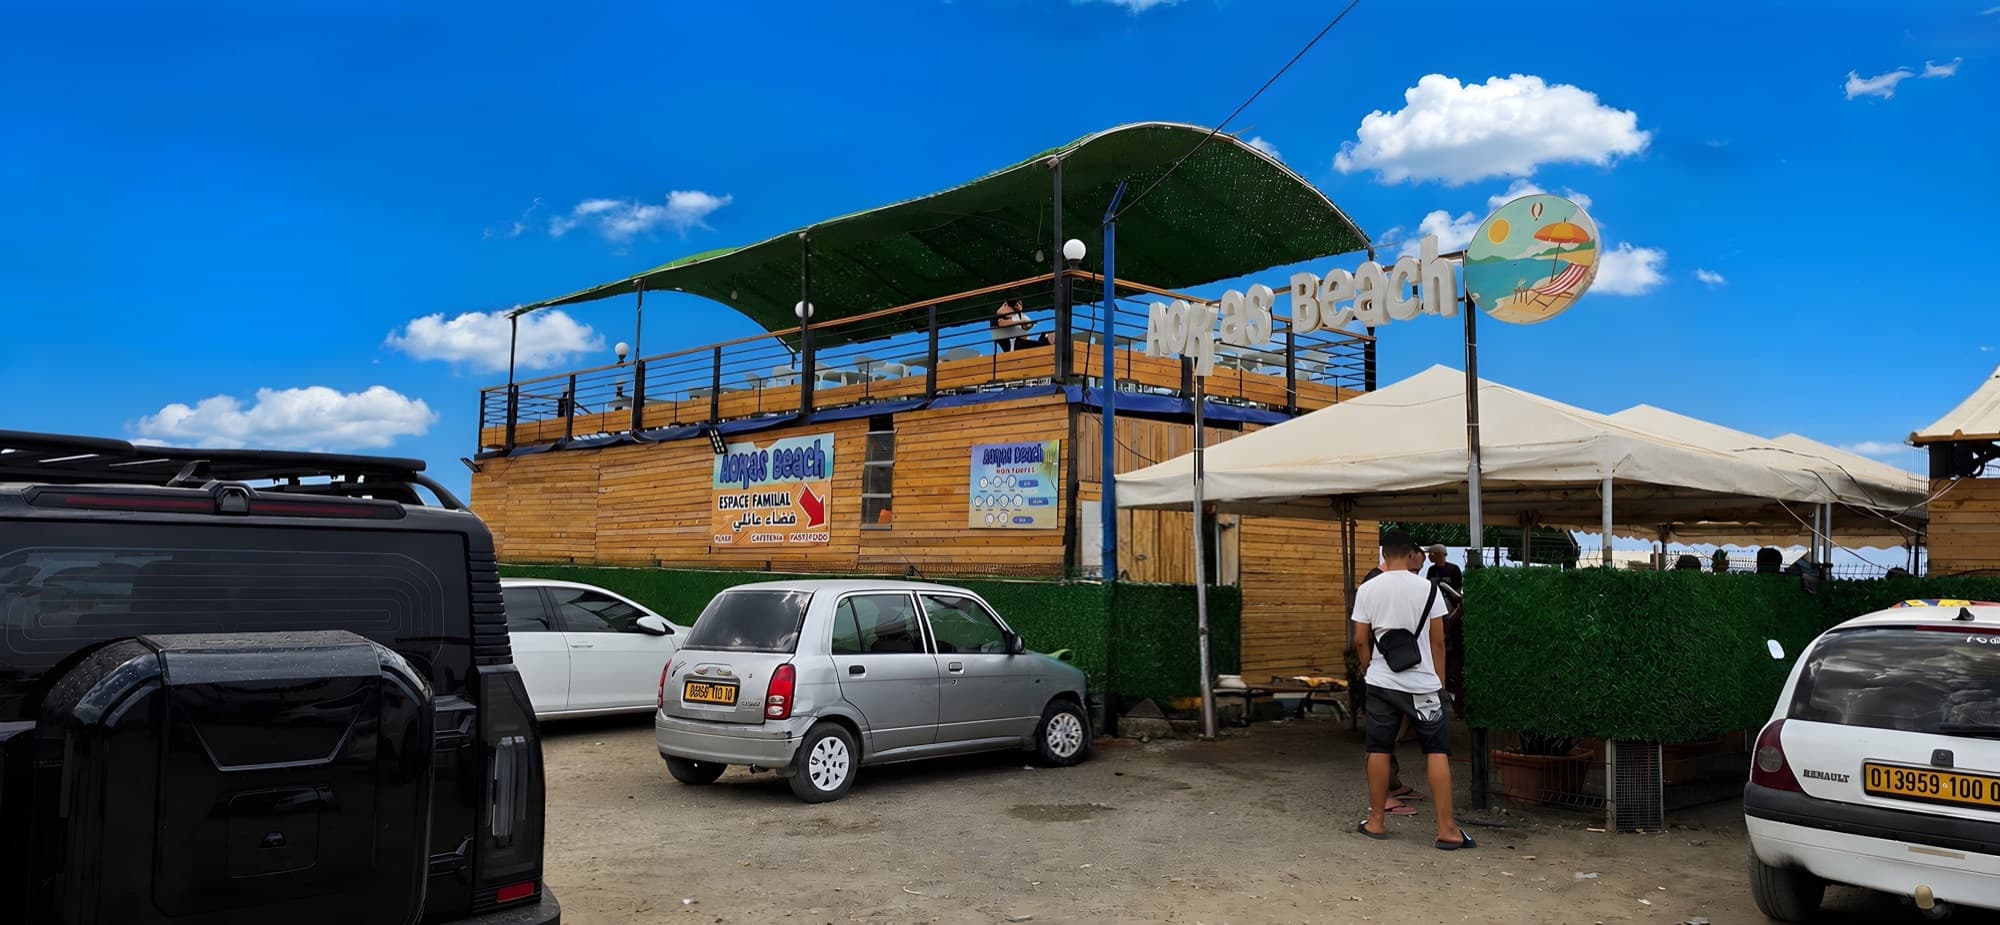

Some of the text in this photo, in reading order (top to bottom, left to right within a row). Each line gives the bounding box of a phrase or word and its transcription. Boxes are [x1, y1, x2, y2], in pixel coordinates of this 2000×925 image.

[1291, 235, 1458, 334] Beach
[772, 438, 826, 480] Beach
[719, 495, 749, 509] ESPACE
[733, 511, 796, 532] فضاء عائلي
[1803, 768, 1850, 783] RENAULT
[1871, 767, 1940, 795] 013959
[1948, 776, 1983, 800] 100
